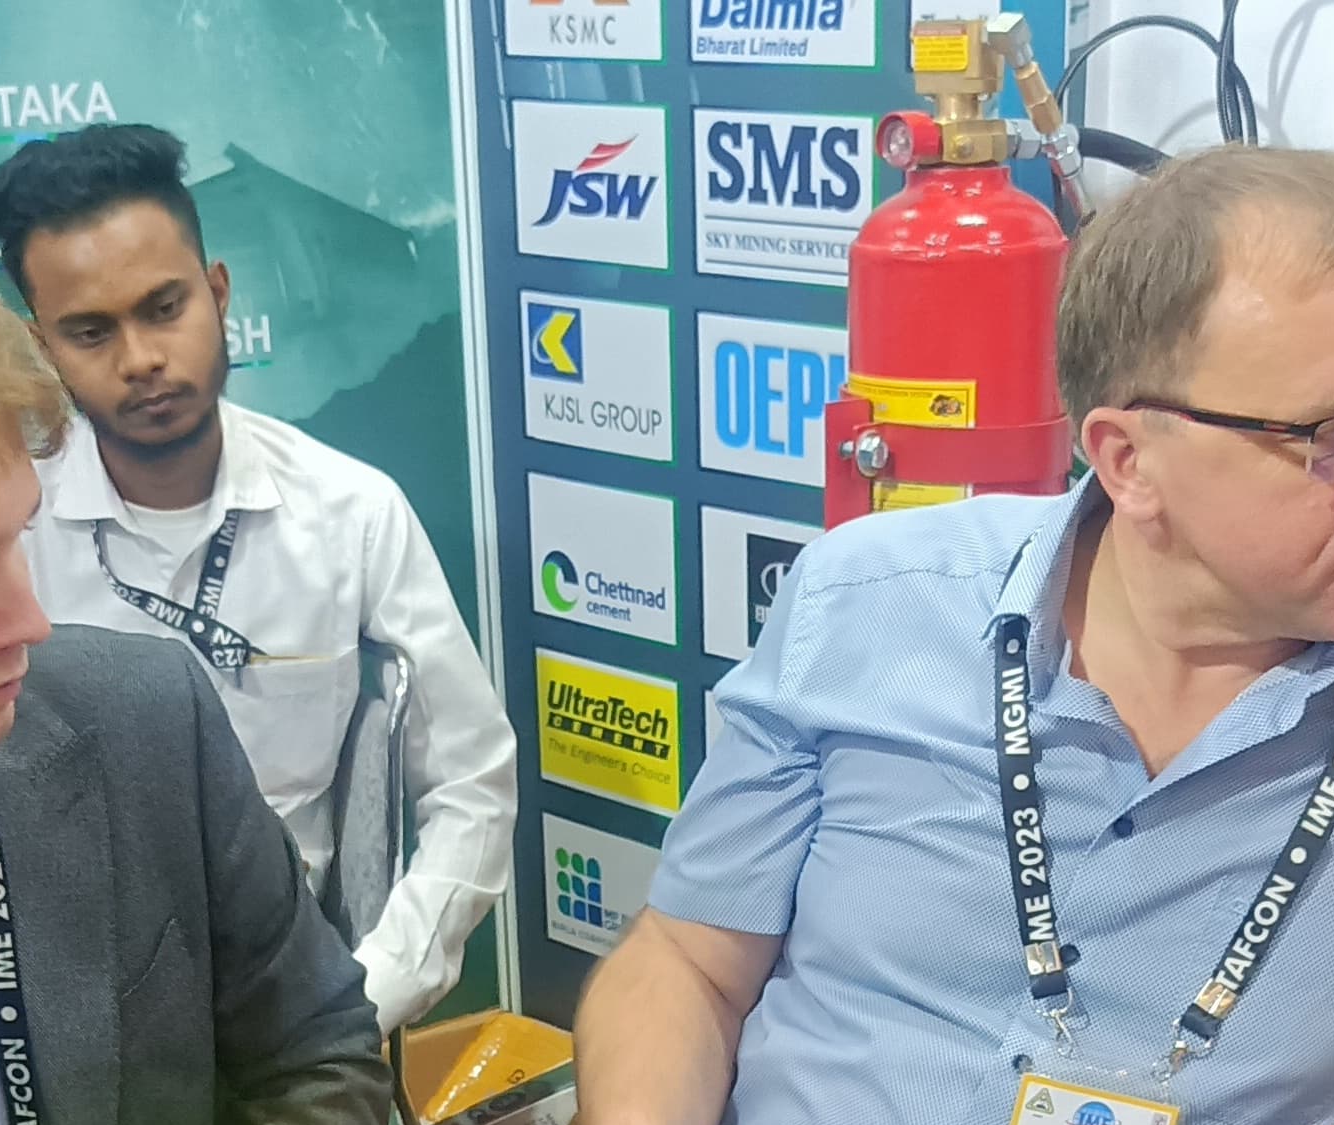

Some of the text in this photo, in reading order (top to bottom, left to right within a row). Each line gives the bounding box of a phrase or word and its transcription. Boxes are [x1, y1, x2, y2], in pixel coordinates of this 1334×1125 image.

[549, 14, 617, 46] KSMC
[696, 38, 808, 57] Bharat Limited
[708, 120, 861, 212] SMS
[533, 168, 658, 227] JSW
[705, 231, 848, 260] SKY MINING SERVICE
[544, 393, 663, 438] KJSL GROUP
[585, 572, 665, 610] Chettinad
[586, 600, 632, 622] cement
[547, 680, 669, 741] UltraTech
[1002, 666, 1031, 756] MGMI
[549, 717, 668, 758] CEMENT
[548, 738, 671, 785] The Engineer's Choice
[1012, 807, 1055, 943] ME 2023
